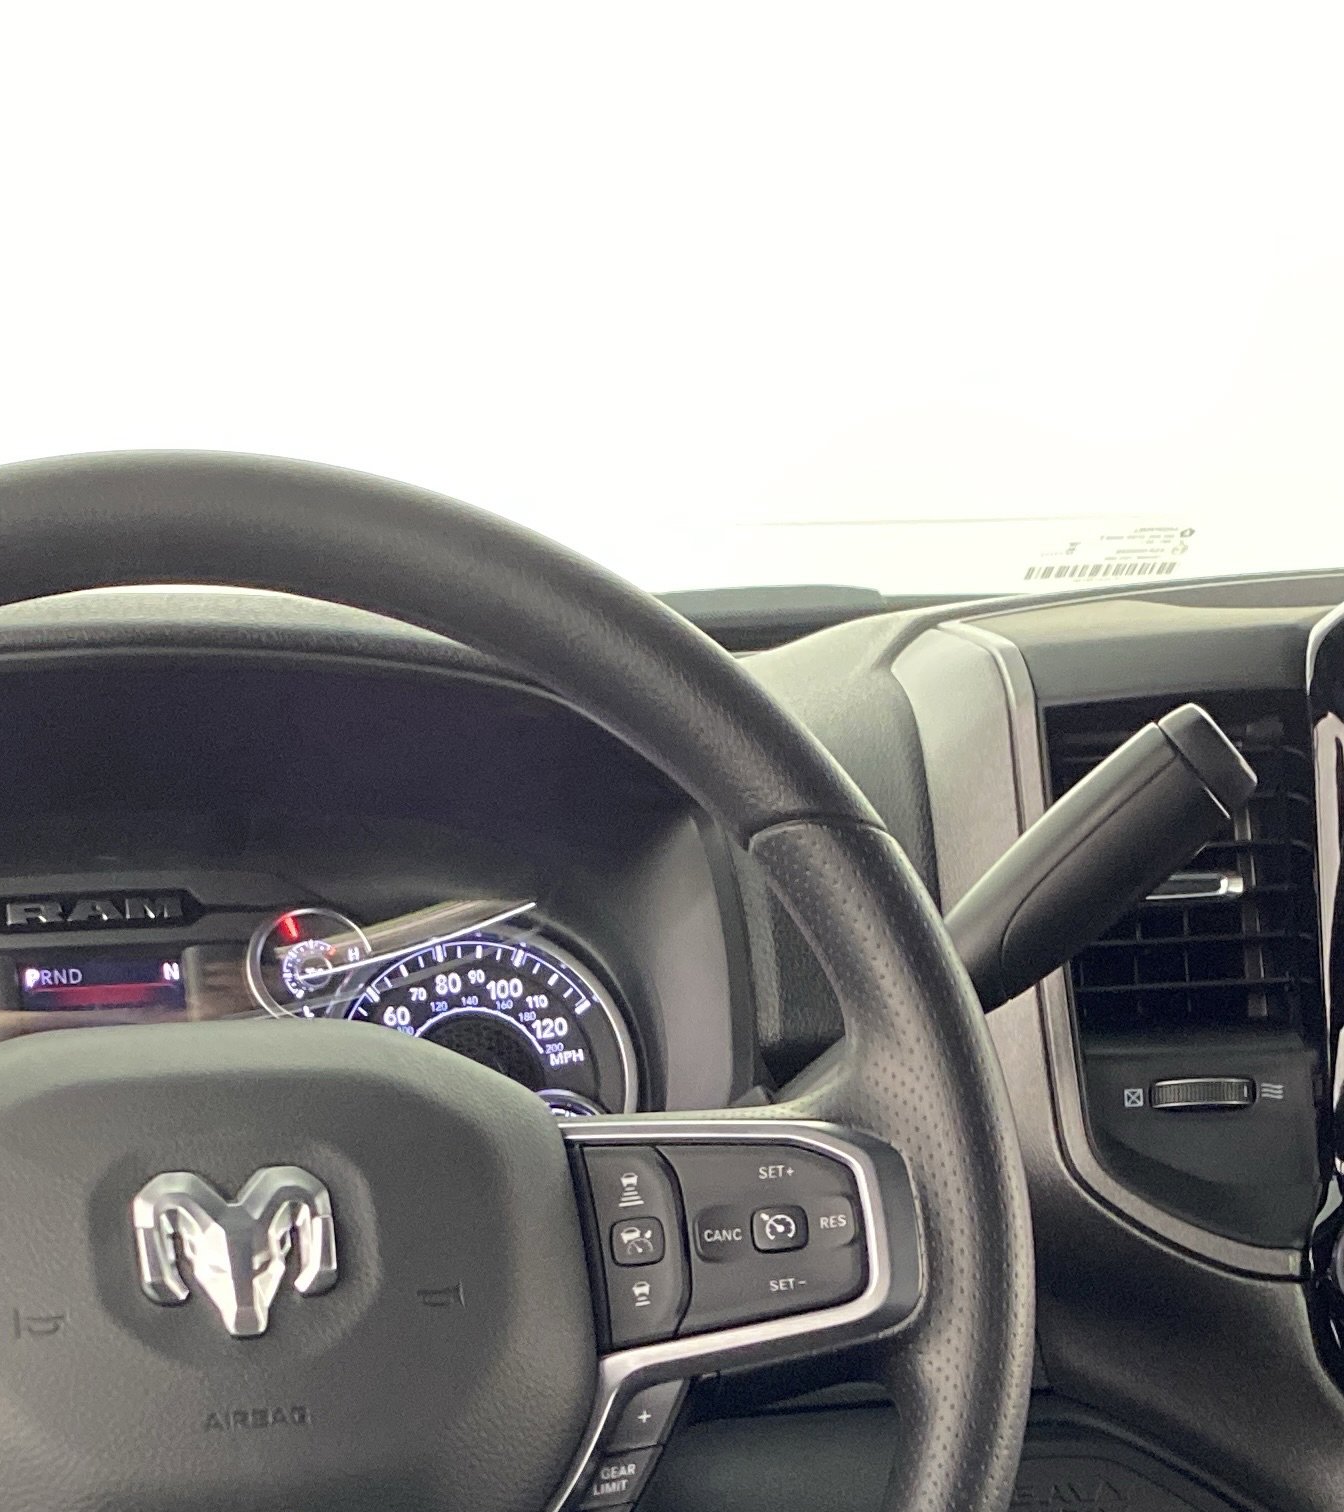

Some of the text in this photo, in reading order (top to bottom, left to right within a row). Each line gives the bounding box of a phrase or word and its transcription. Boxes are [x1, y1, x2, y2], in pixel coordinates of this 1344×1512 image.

[6, 898, 184, 926] RAM
[163, 962, 180, 981] N
[467, 969, 485, 984] 90
[435, 972, 462, 995] 80
[486, 977, 523, 1000] 100
[409, 987, 427, 1001] 70
[461, 995, 479, 1006] 140
[526, 994, 549, 1009] 110
[430, 1000, 448, 1012] 120
[496, 1000, 513, 1011] 160
[383, 1005, 411, 1027] 60
[518, 1011, 536, 1023] 180
[531, 1017, 568, 1039] 120
[545, 1042, 564, 1054] 200
[549, 1048, 585, 1067] MPH
[819, 1215, 847, 1230] RES
[704, 1228, 742, 1242] CANC
[203, 1406, 312, 1433] AIRBAG
[600, 1463, 637, 1480] GEAR
[593, 1479, 629, 1496] LIMIT
